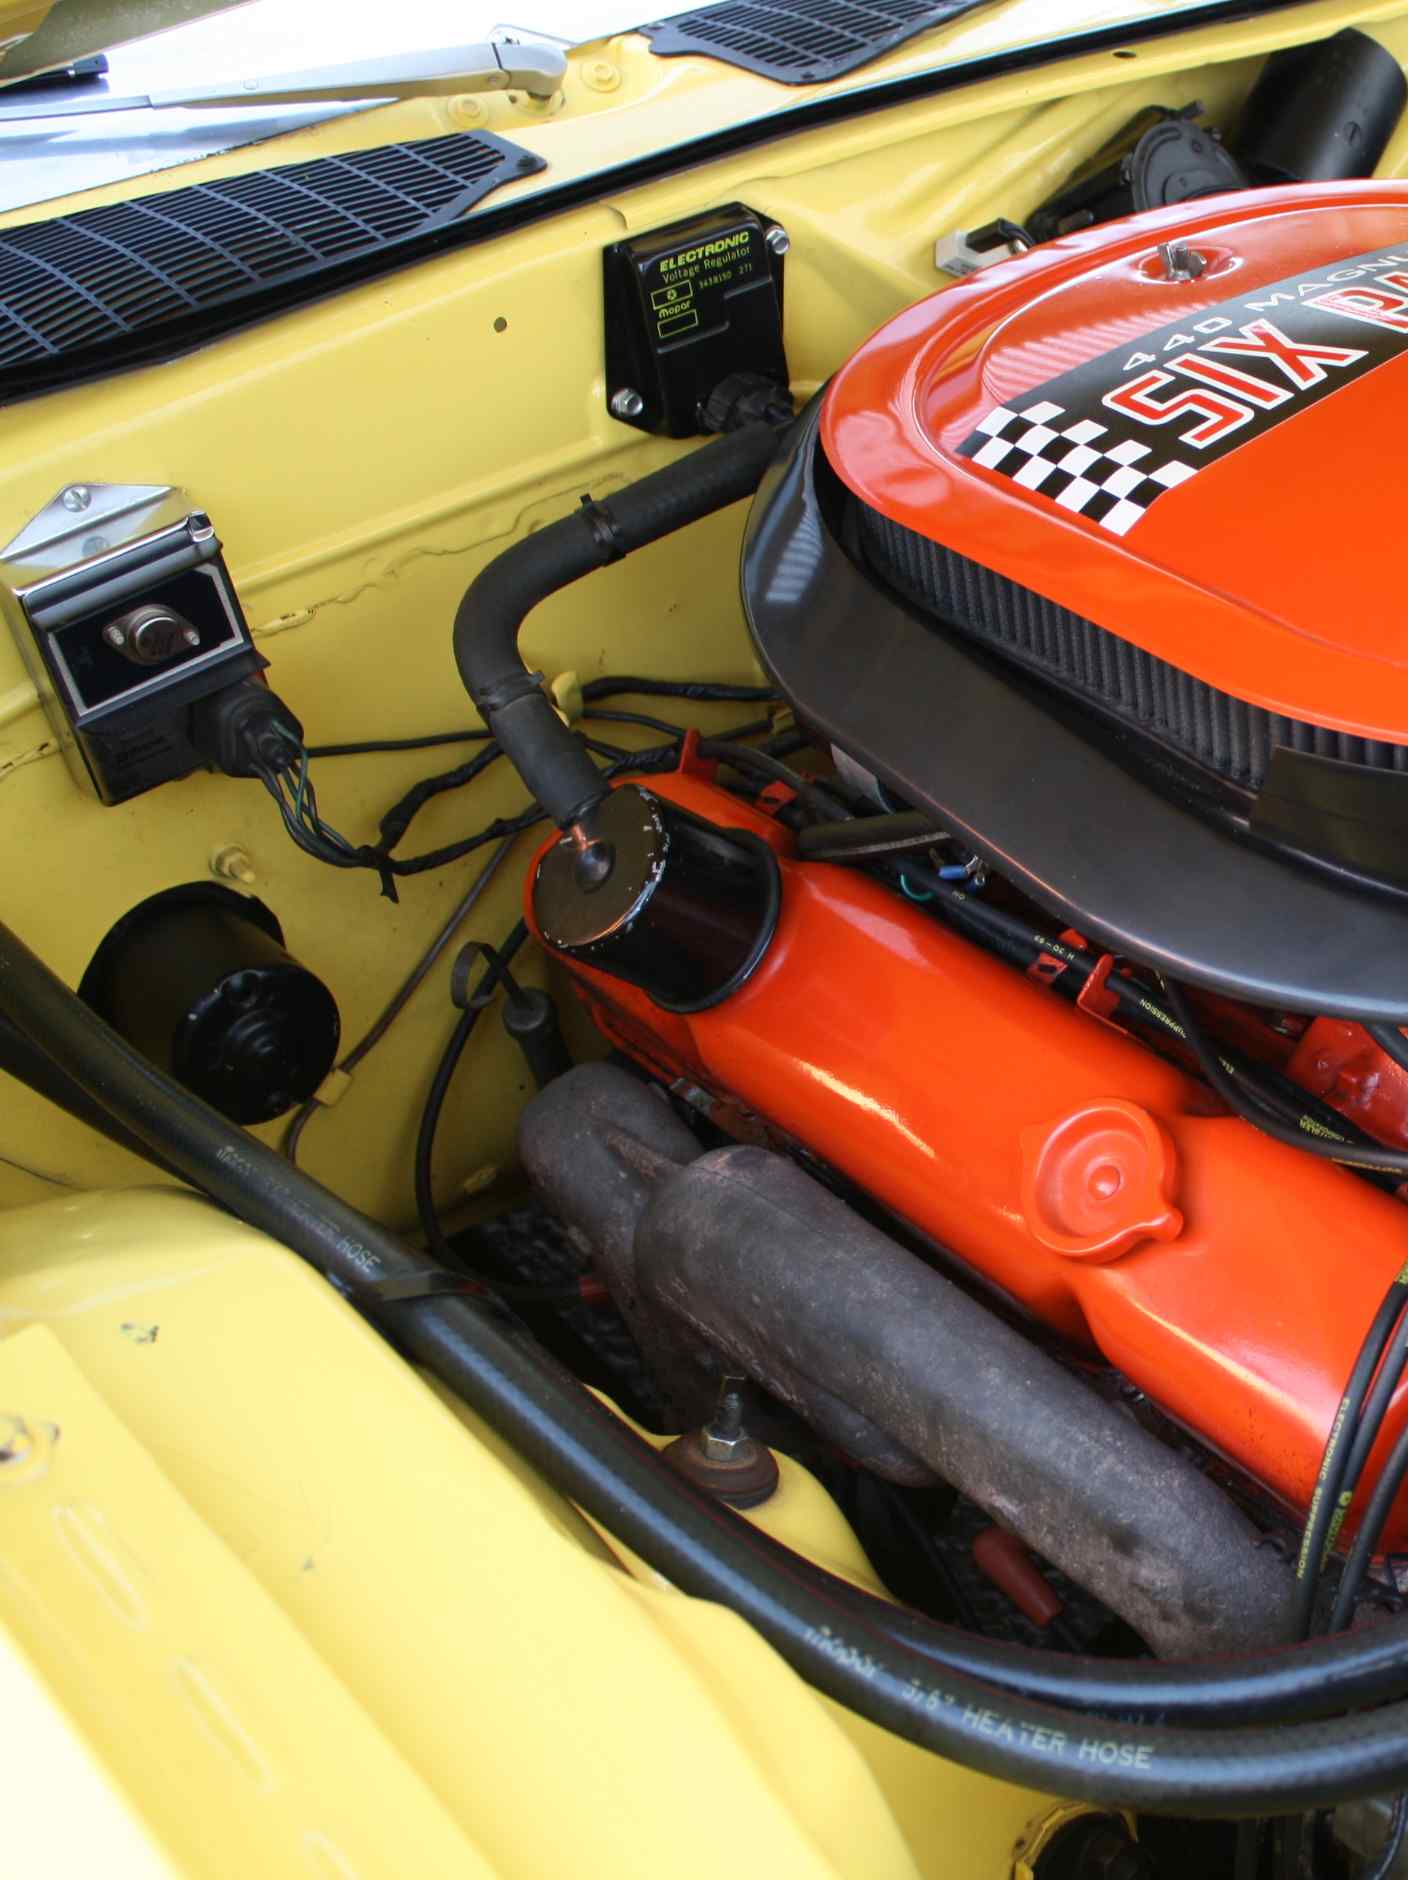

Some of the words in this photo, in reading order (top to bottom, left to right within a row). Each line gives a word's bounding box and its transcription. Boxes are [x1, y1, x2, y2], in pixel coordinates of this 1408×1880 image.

[660, 231, 750, 272] ELECTRONIC
[662, 264, 700, 284] Voltage
[703, 246, 751, 270] Regulator
[1123, 316, 1233, 371] 440
[1101, 318, 1370, 449] SIX
[335, 1235, 382, 1273] HOSE
[1319, 1397, 1350, 1481] ELECTRONIC
[960, 1705, 1068, 1758] HEATER
[1077, 1737, 1156, 1771] HOSE
